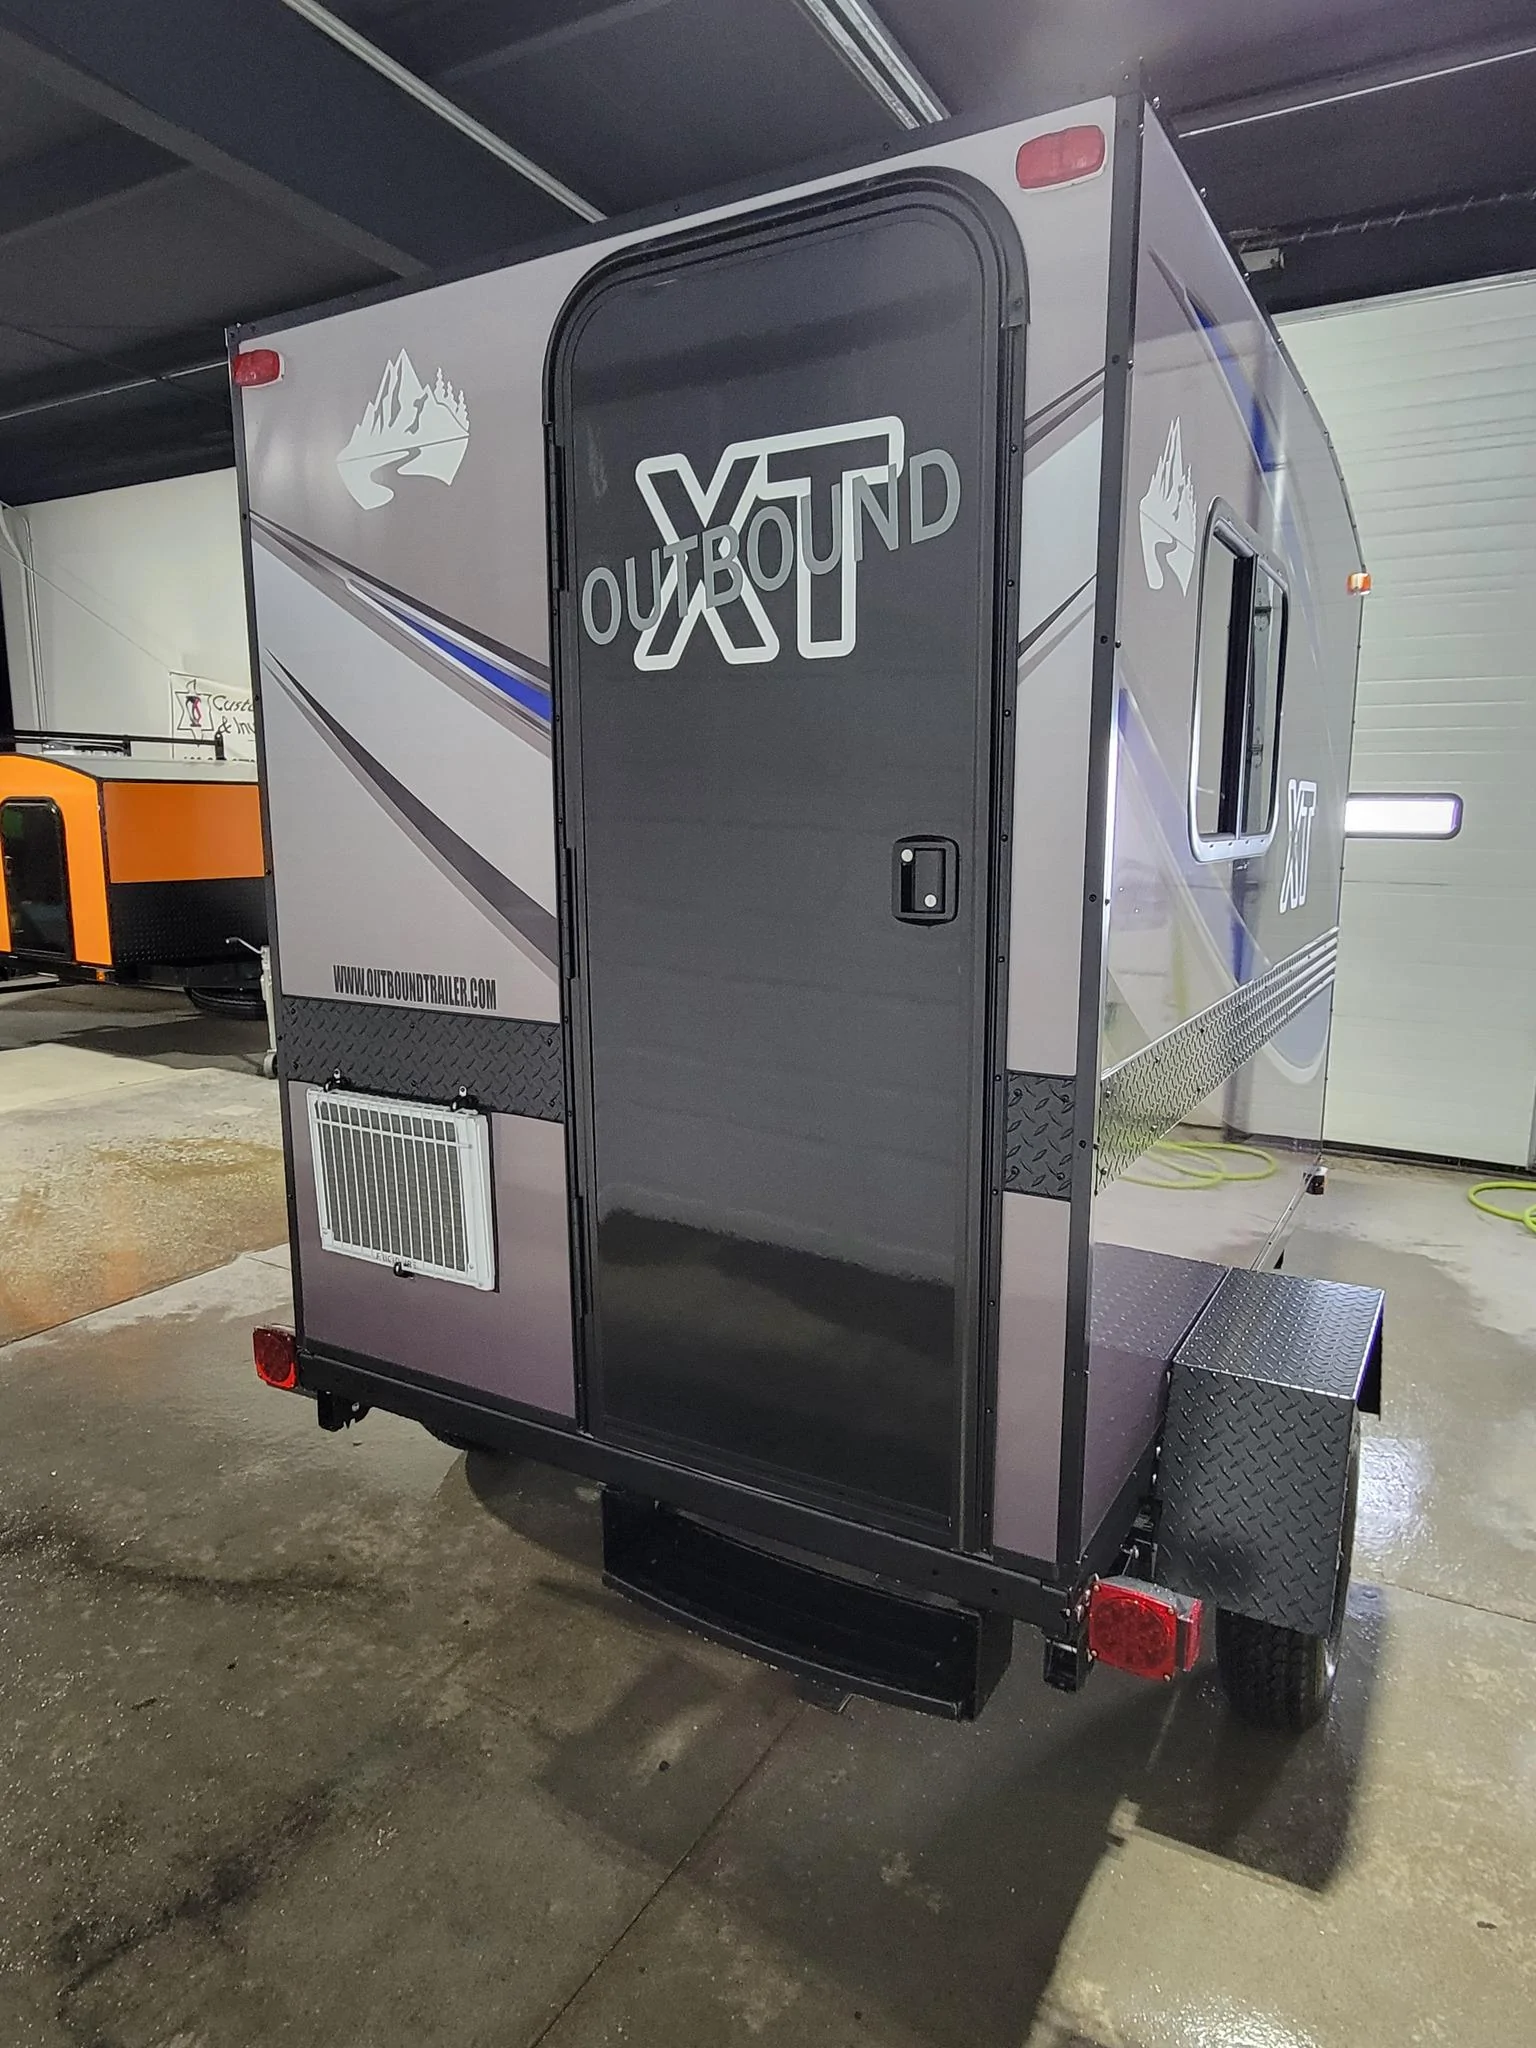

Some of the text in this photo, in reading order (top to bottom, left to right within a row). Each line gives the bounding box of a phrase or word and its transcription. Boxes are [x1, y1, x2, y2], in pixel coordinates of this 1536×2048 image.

[582, 448, 961, 645] OUTBOUND
[634, 415, 905, 671] XT
[218, 715, 231, 734] &
[1279, 778, 1317, 914] XT
[333, 964, 497, 1010] WWW.OUTBOUNDTRAILER.COM
